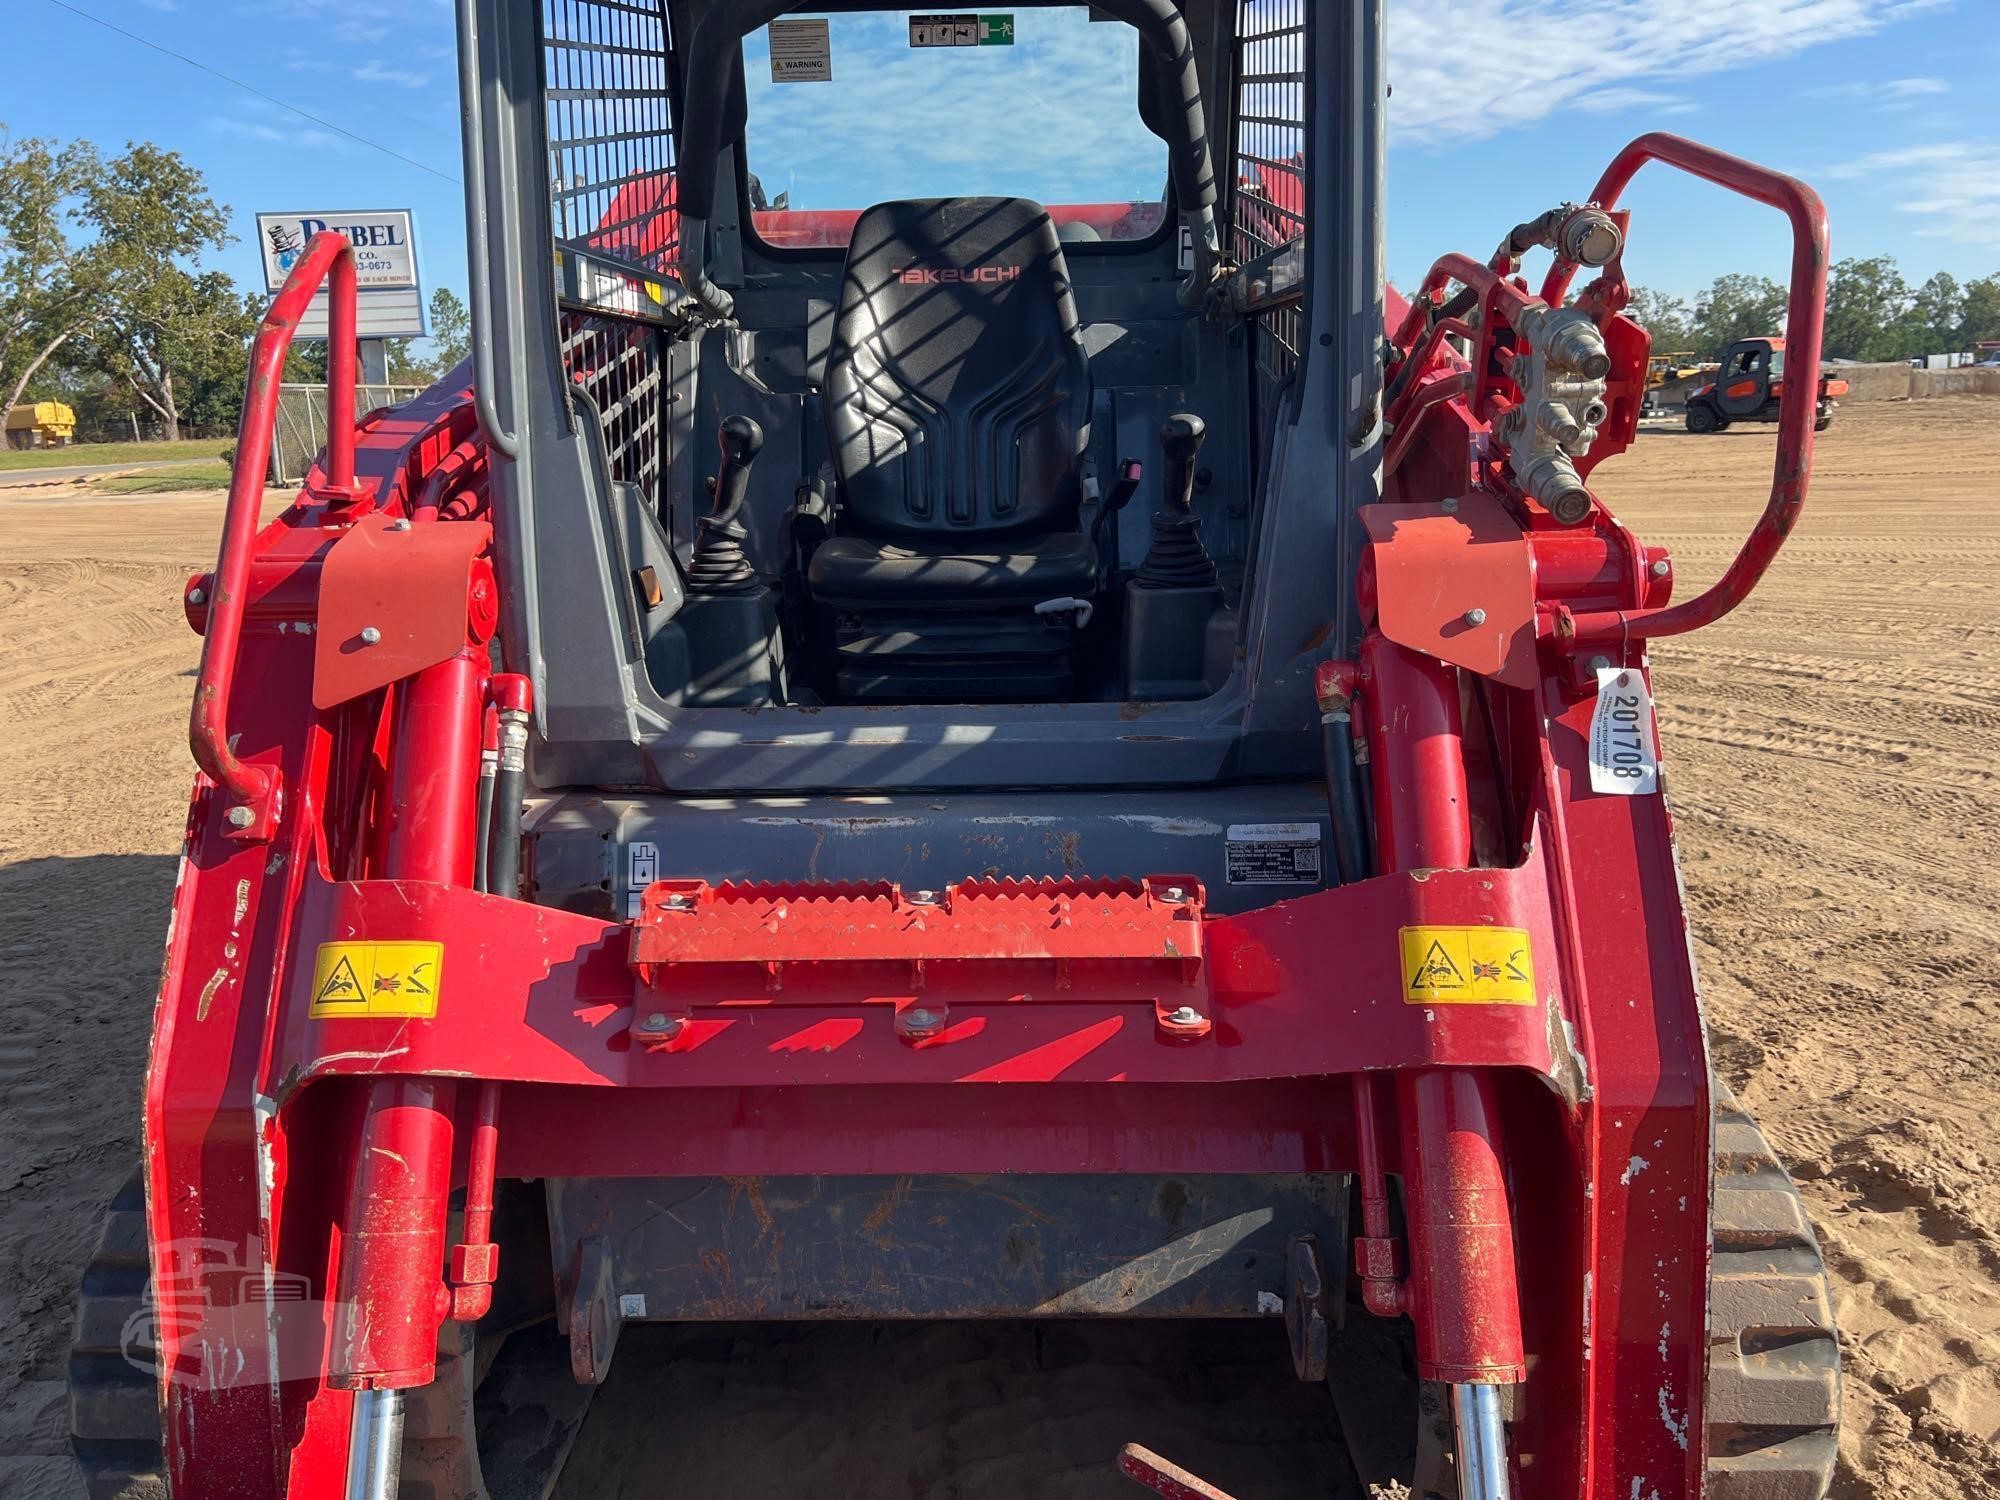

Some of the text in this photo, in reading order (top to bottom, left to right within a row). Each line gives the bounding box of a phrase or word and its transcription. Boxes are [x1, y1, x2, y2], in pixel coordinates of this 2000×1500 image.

[785, 60, 823, 69] WARNING
[358, 252, 378, 260] CO.
[1612, 696, 1642, 778] 201708
